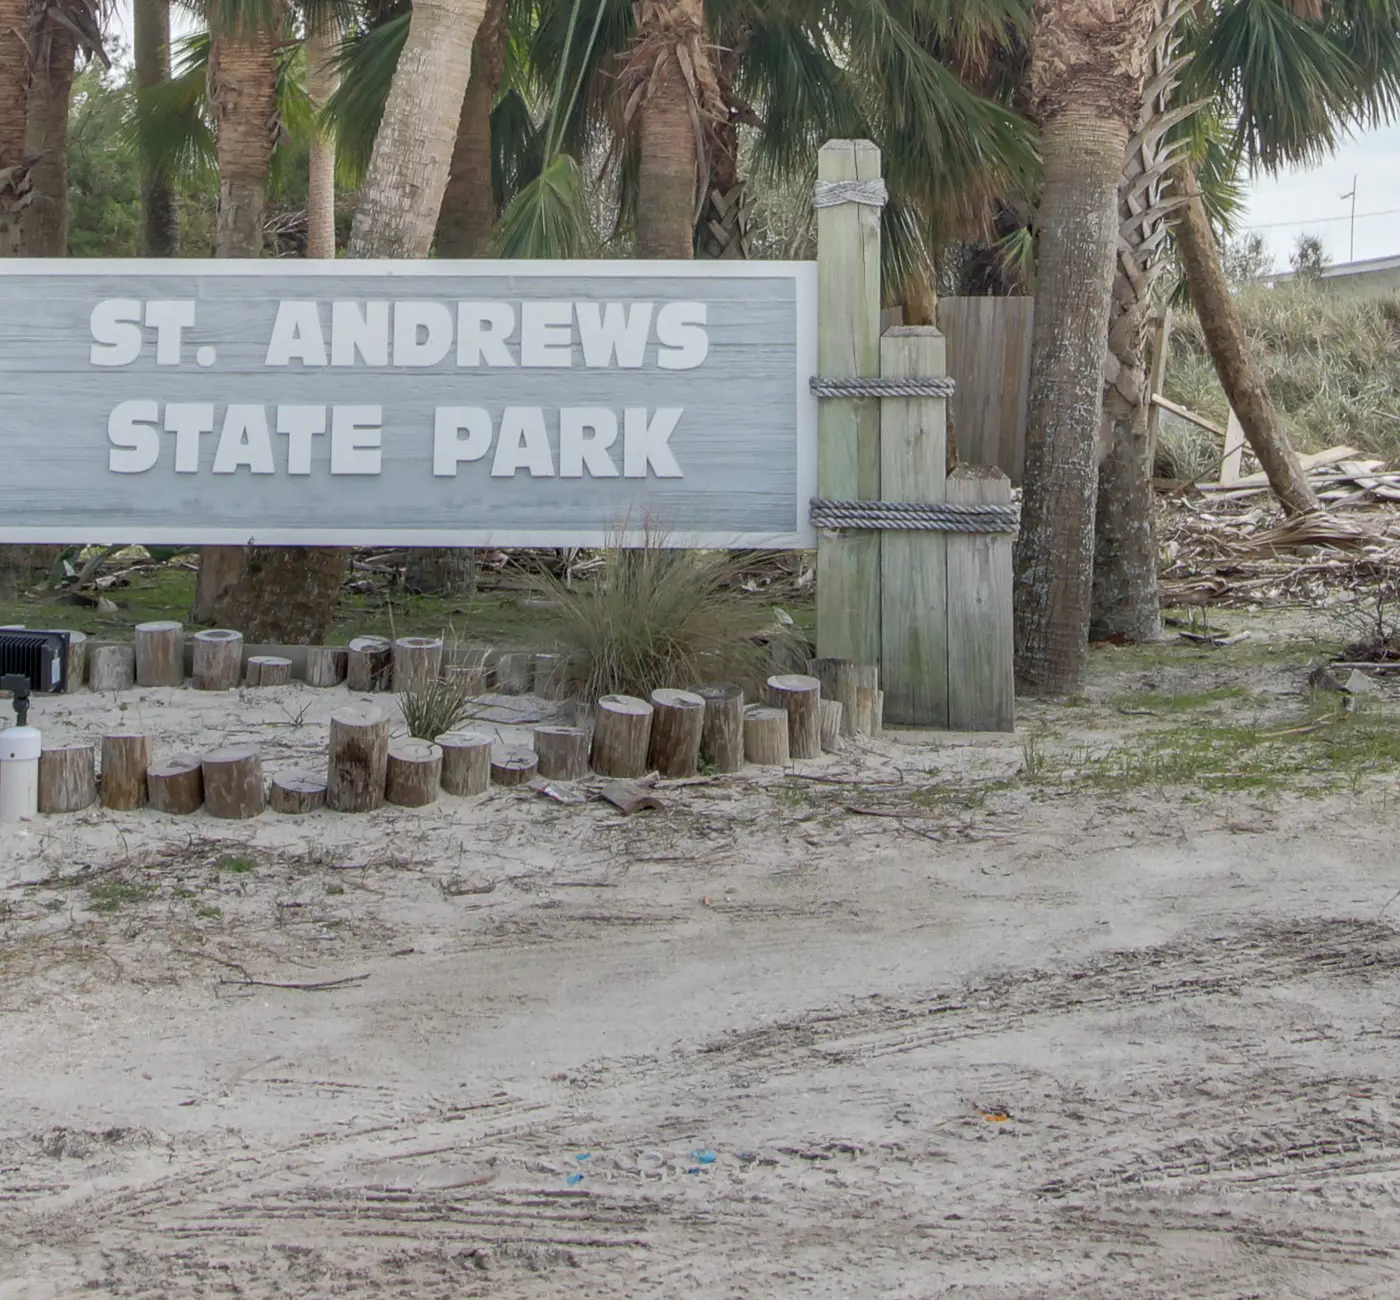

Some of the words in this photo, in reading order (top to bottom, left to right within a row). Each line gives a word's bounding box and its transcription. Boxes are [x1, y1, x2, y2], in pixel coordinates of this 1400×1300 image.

[89, 298, 216, 367] ST.
[265, 300, 709, 370] ANDREWS
[107, 400, 383, 476] STATE
[432, 406, 684, 479] PARK
